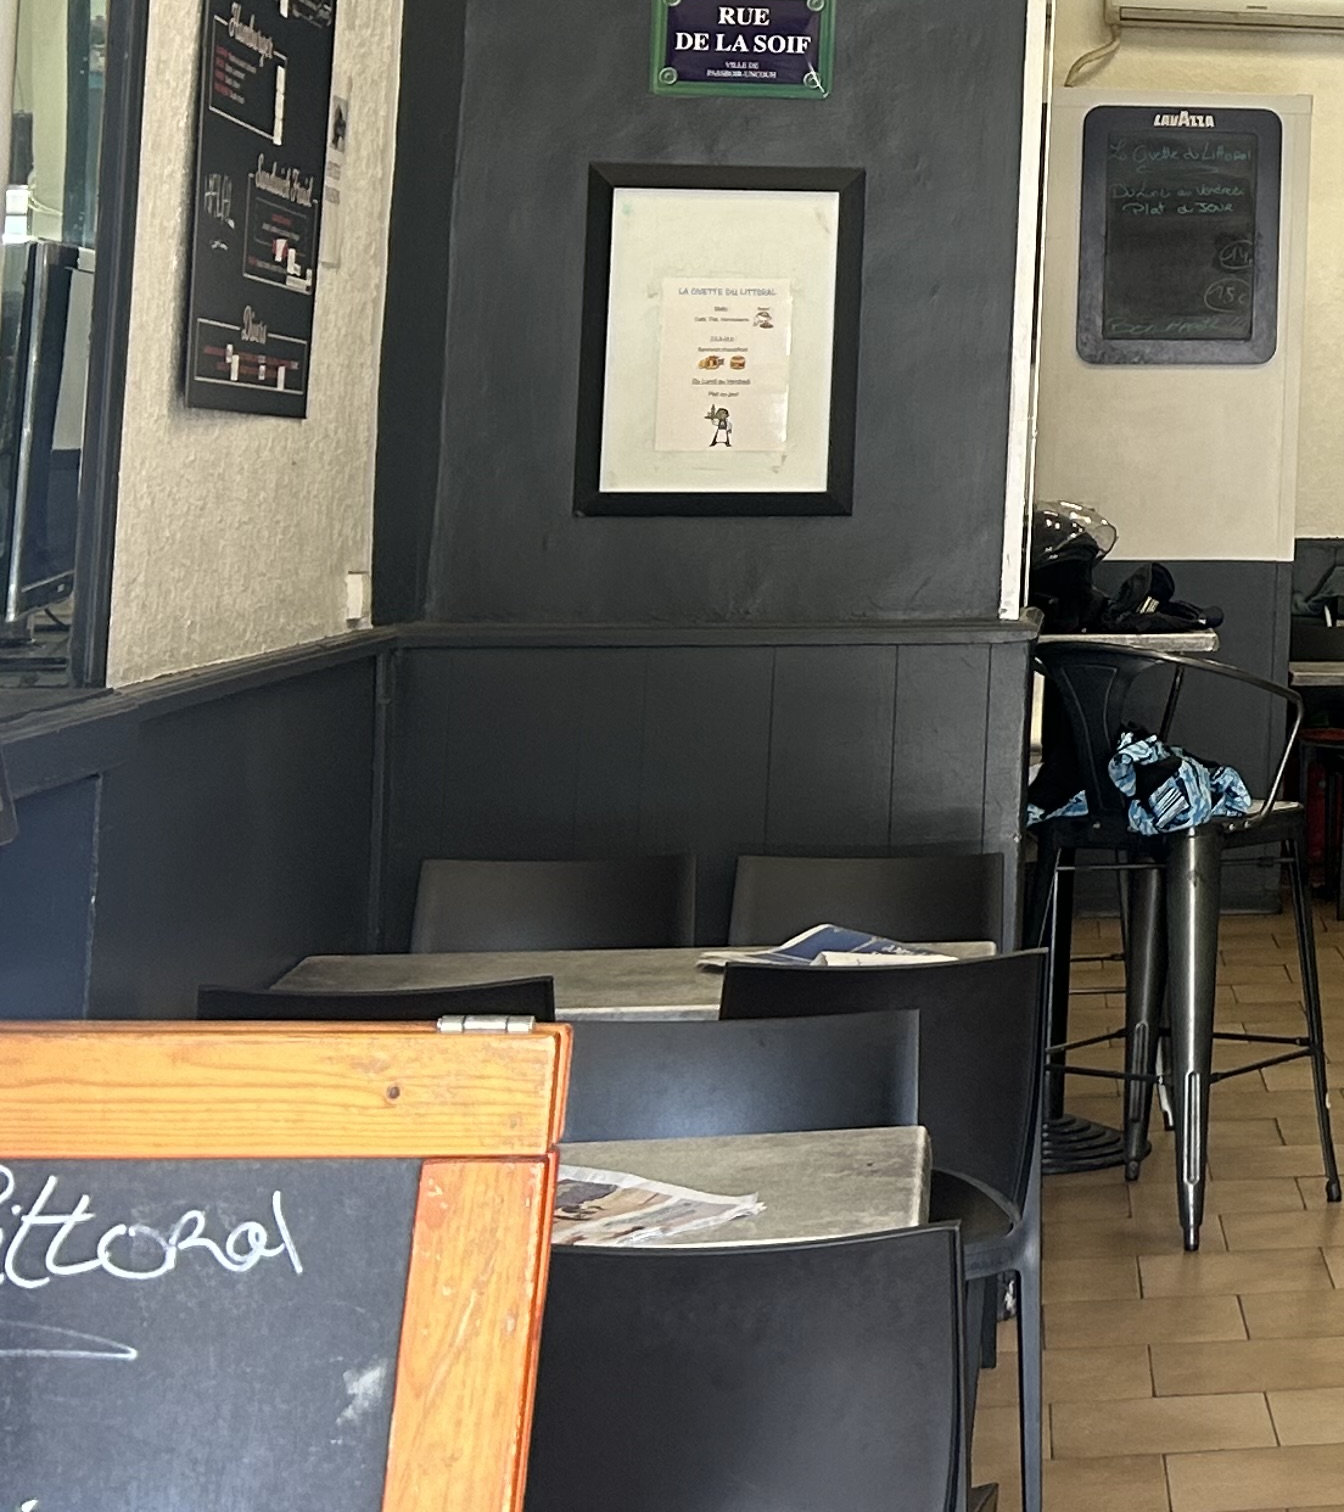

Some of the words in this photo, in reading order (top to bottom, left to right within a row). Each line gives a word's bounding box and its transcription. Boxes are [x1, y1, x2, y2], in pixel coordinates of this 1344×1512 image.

[718, 7, 770, 26] RUE
[675, 32, 709, 51] DE
[715, 33, 749, 52] LA
[753, 35, 812, 54] SOIF
[1153, 110, 1216, 129] LAVAZZA
